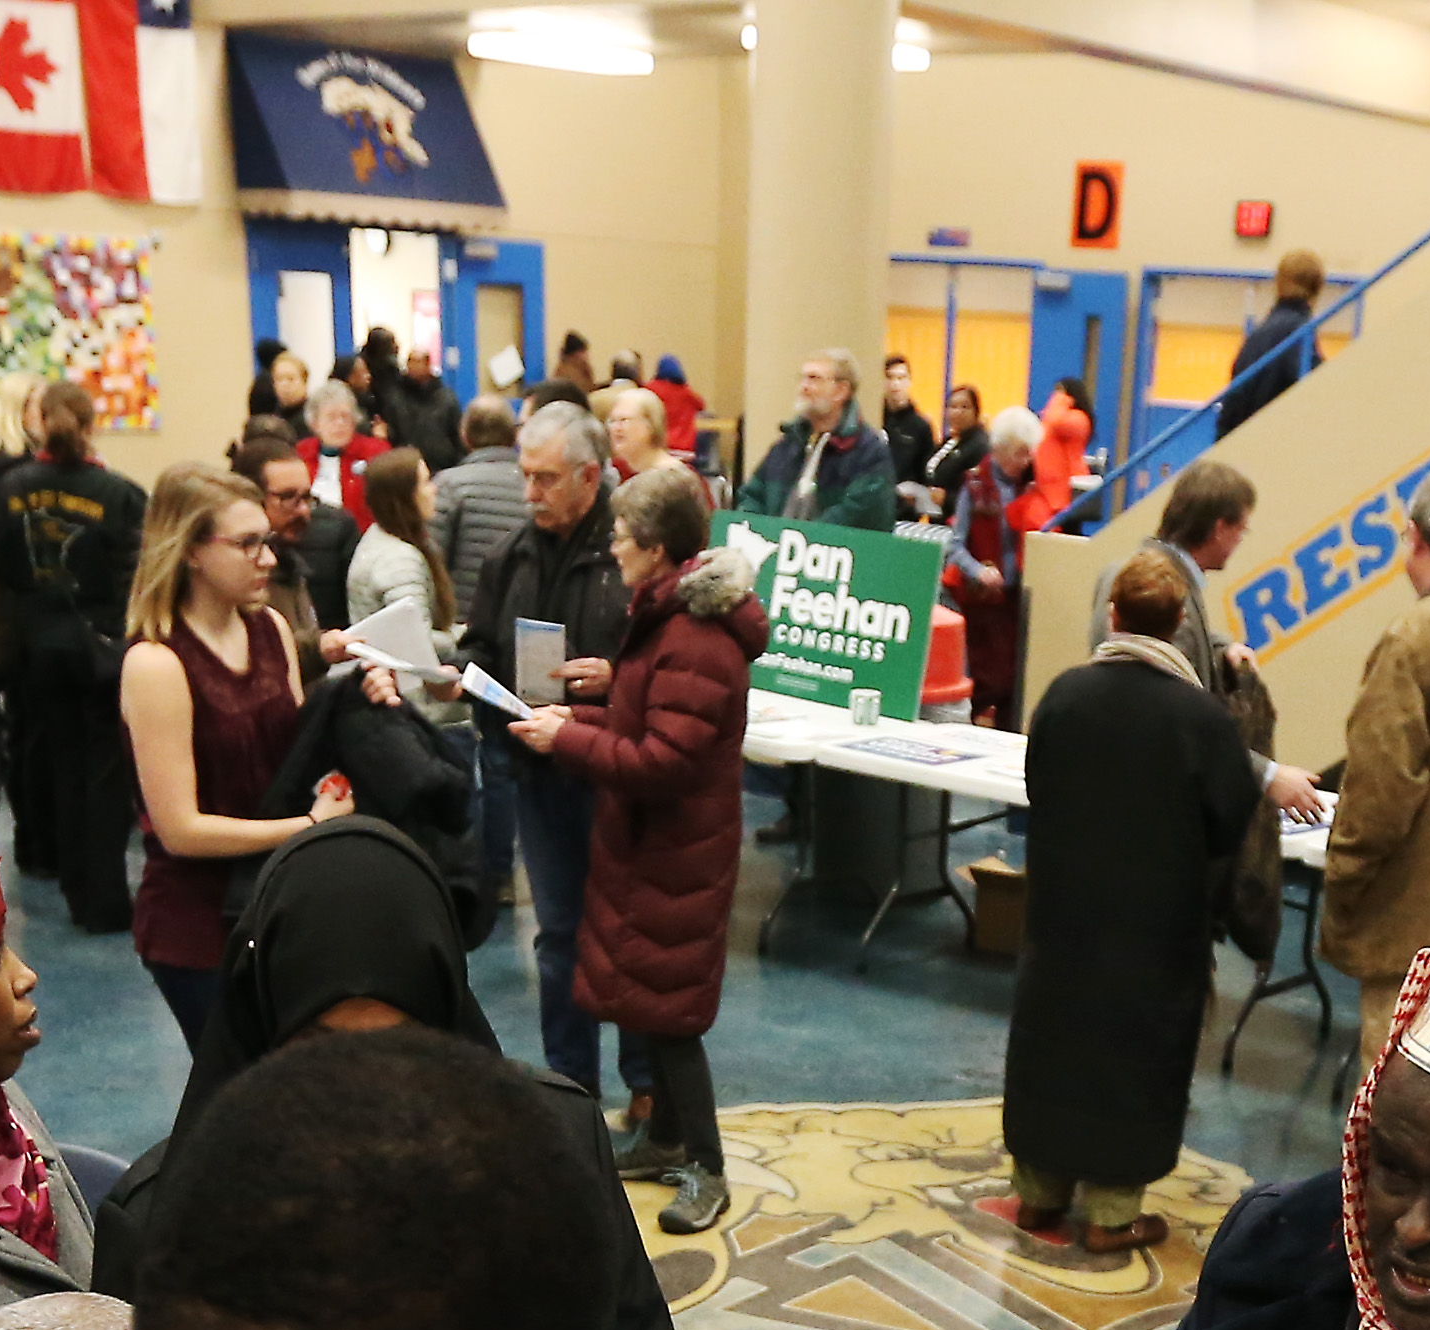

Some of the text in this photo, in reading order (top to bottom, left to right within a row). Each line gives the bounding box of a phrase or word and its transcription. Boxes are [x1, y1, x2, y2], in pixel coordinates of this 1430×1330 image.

[1077, 172, 1117, 240] D
[776, 528, 854, 583] Dan
[769, 574, 912, 643] Feehan
[774, 624, 886, 662] CONGRESS
